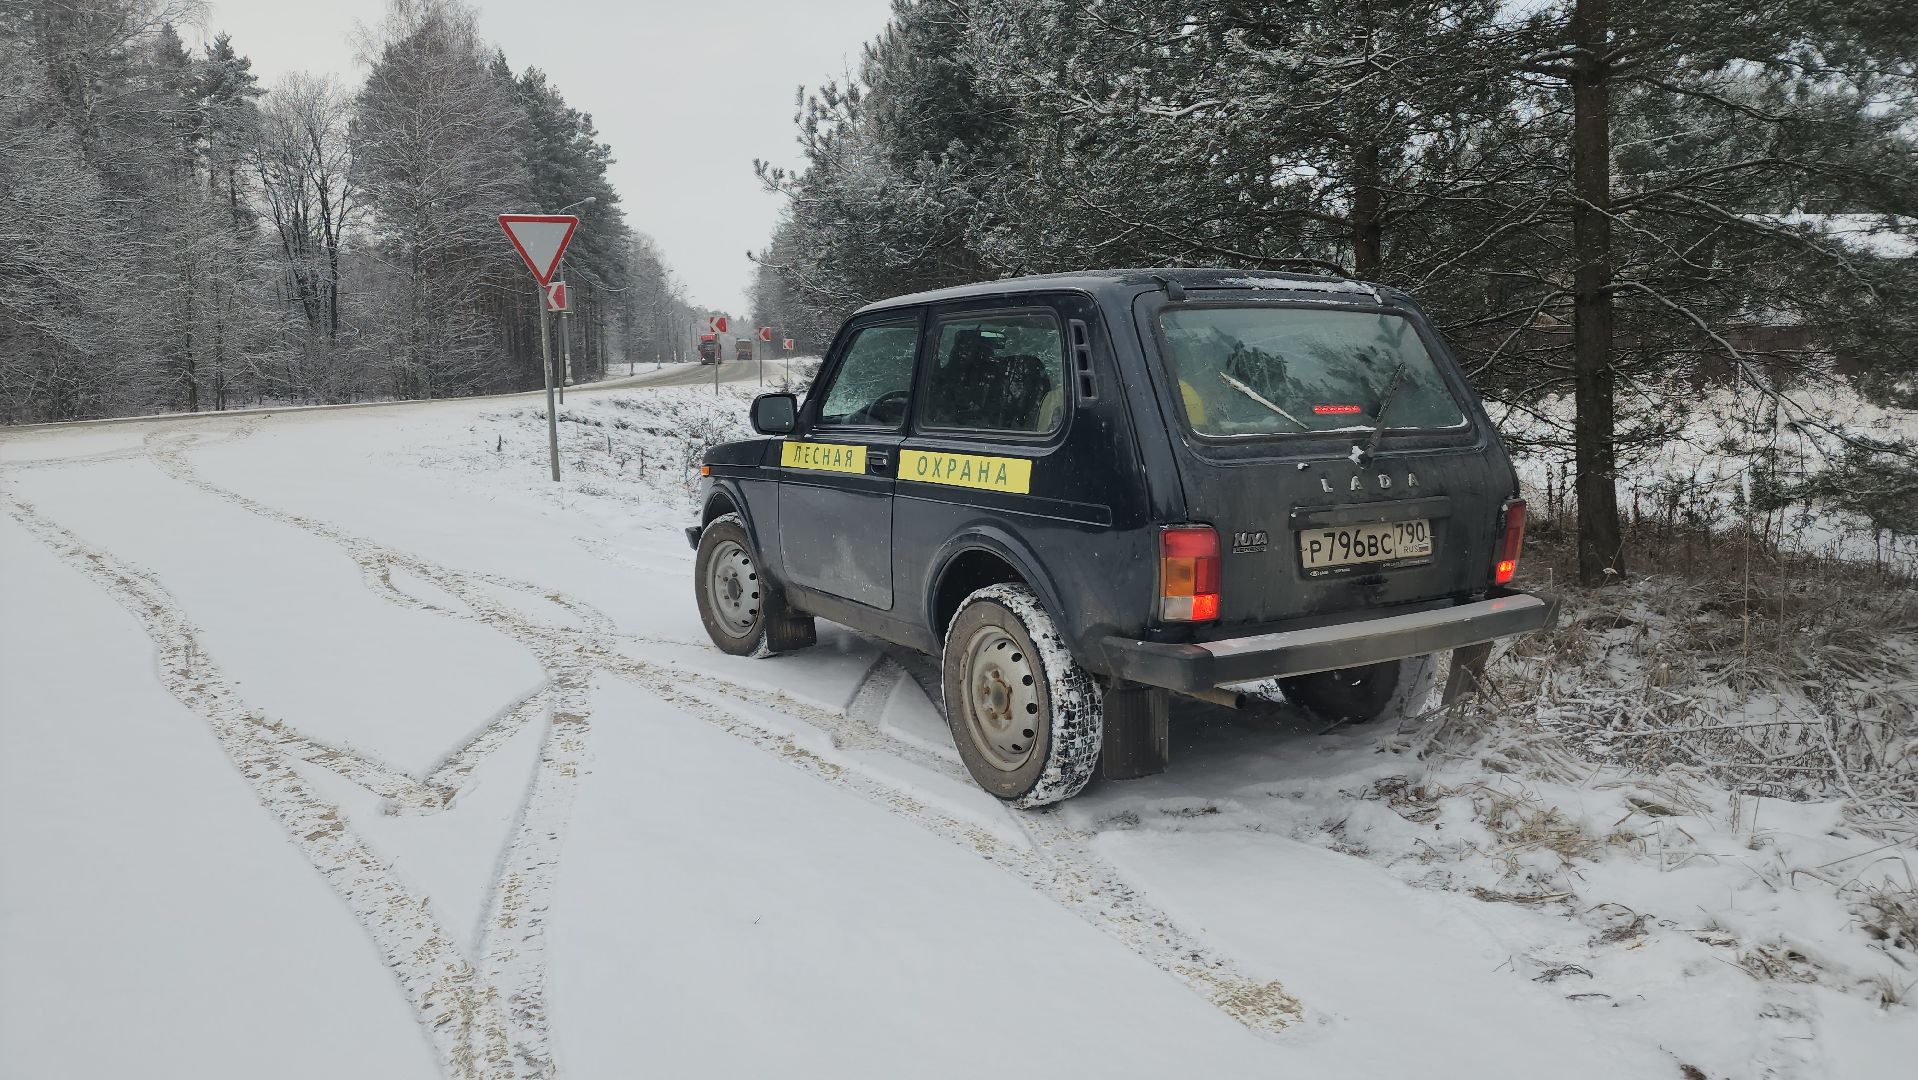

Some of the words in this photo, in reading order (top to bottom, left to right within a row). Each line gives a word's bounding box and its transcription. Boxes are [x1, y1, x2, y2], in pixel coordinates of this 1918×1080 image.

[793, 445, 853, 468] ЛЕСНАЯ
[916, 455, 1008, 486] ОХРАНА
[1320, 472, 1420, 493] LADA
[1395, 521, 1426, 545] 790
[1403, 544, 1420, 554] RUS
